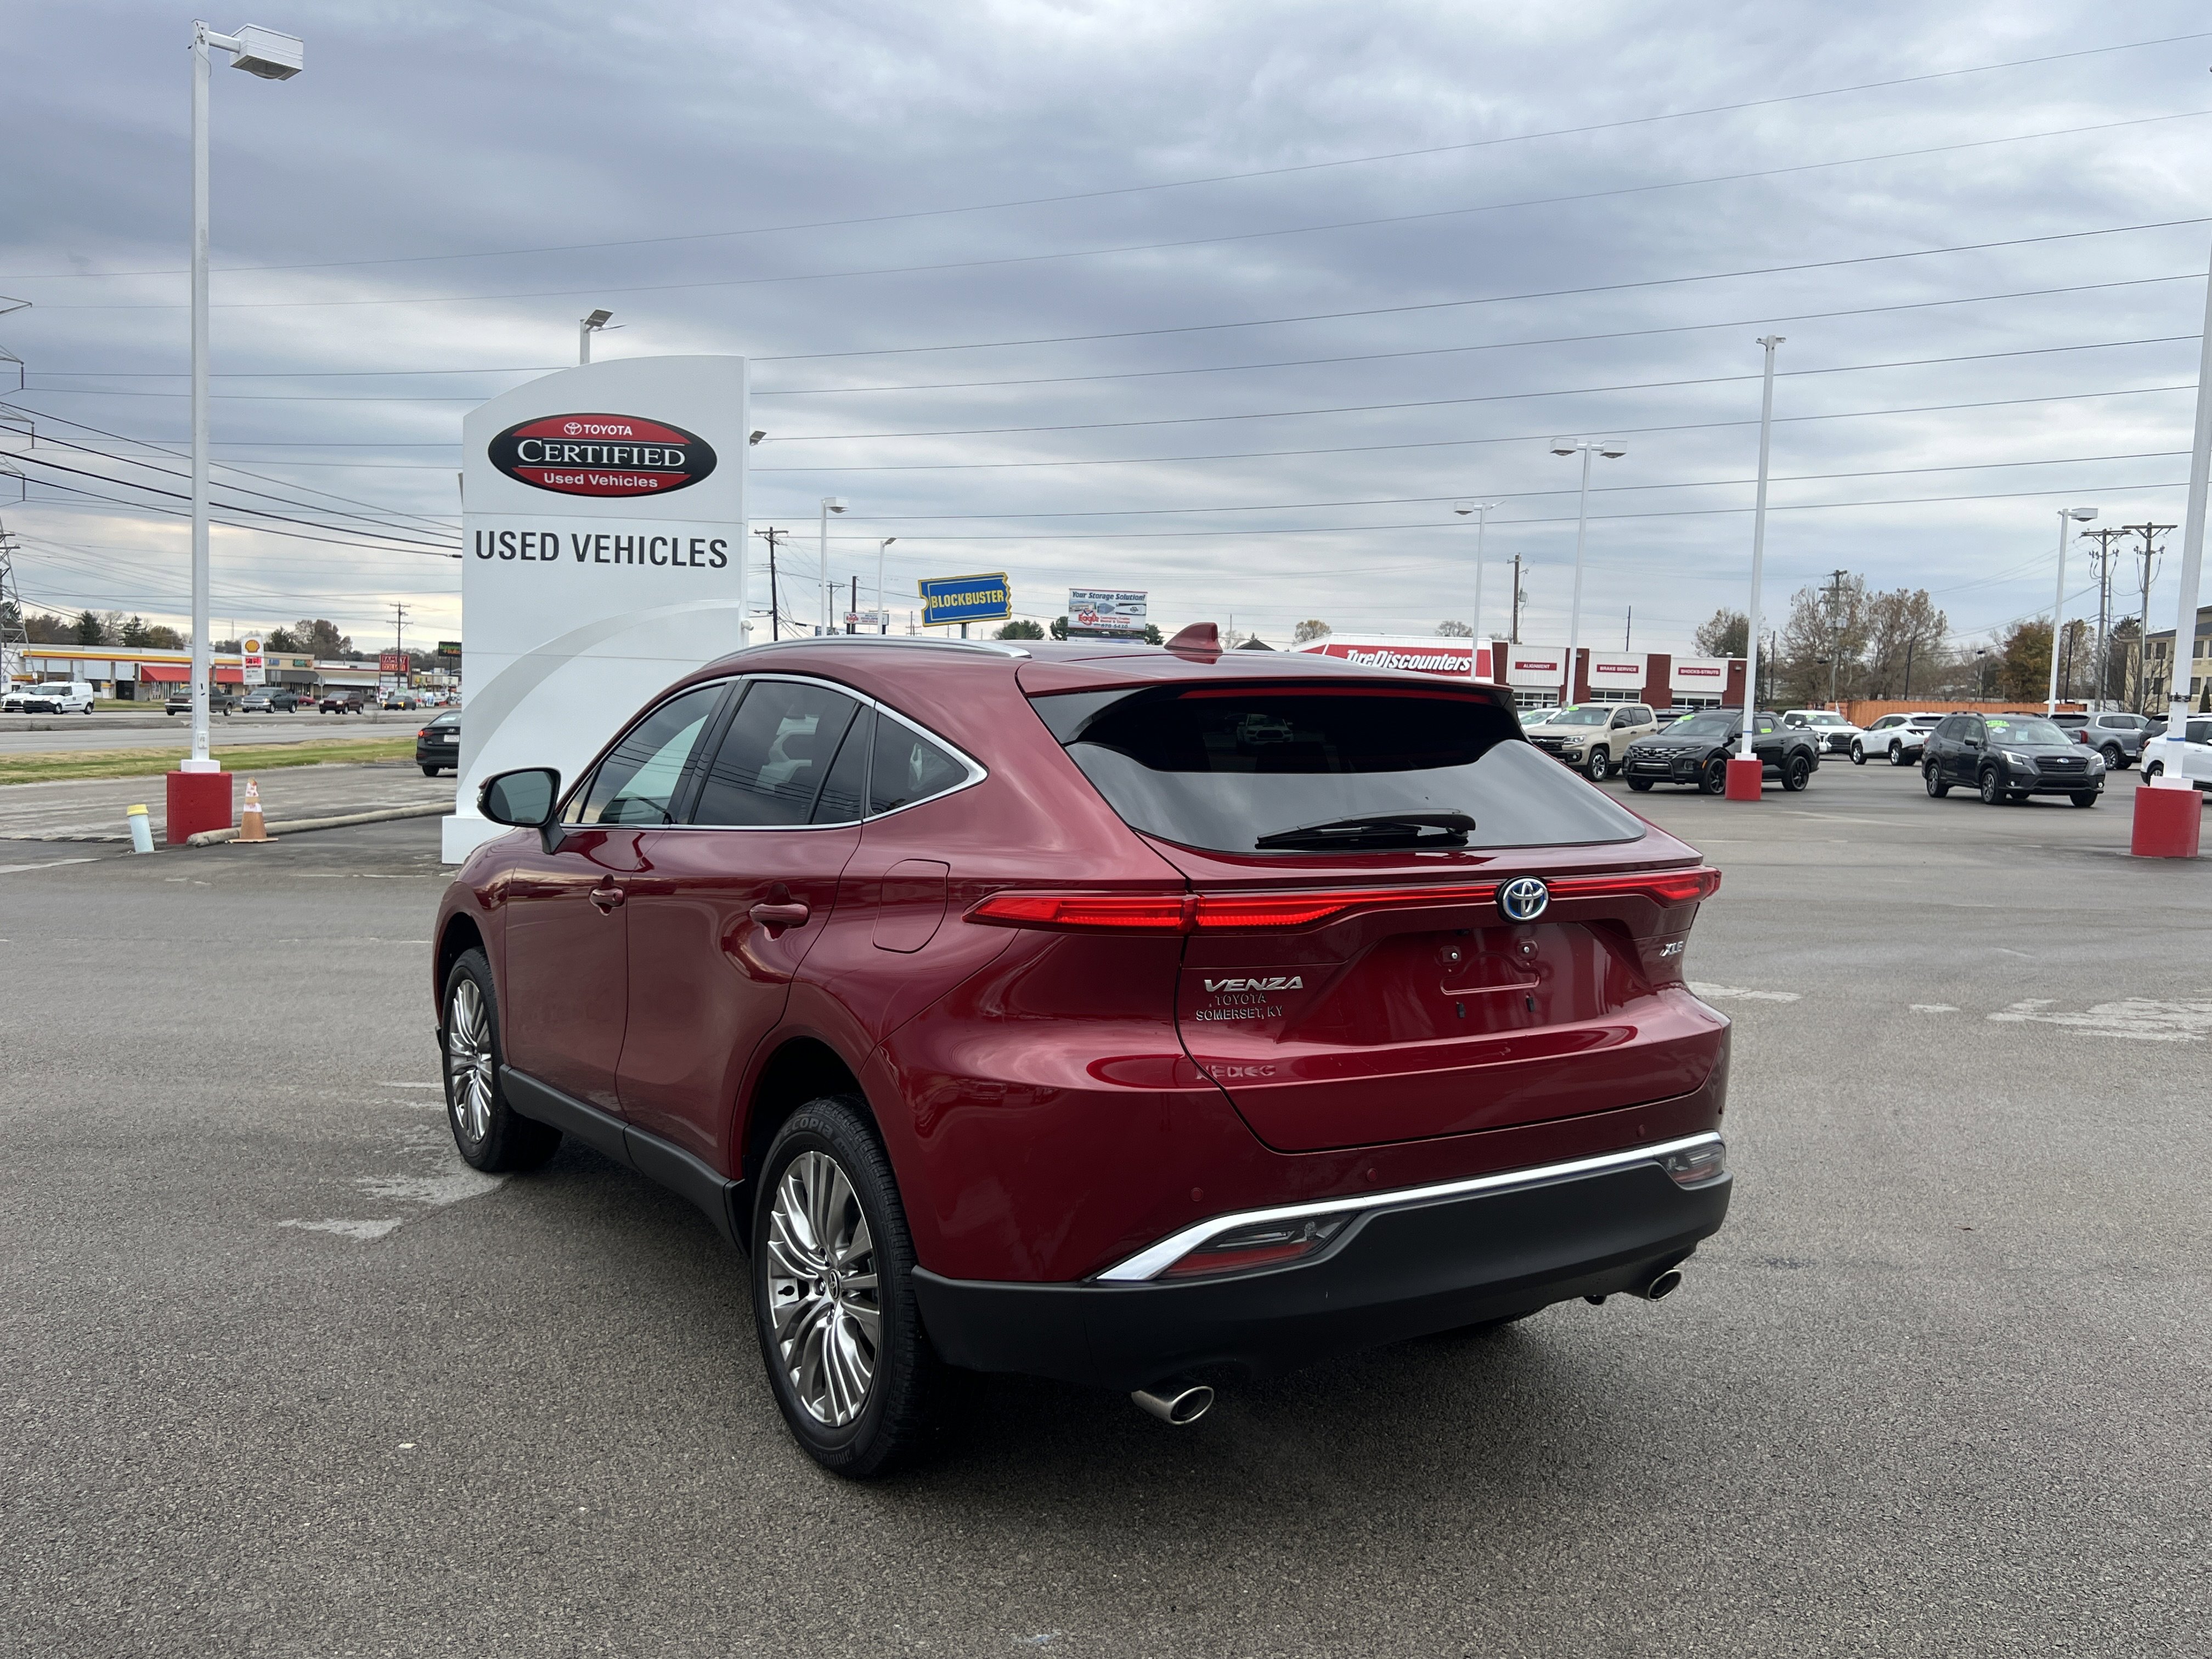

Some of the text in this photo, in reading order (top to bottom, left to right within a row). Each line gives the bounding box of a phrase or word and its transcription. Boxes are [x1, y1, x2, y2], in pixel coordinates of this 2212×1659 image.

[583, 424, 633, 436] TOYOTA
[517, 439, 686, 467] CERTIFIED
[543, 472, 658, 488] Used Vehicles
[475, 530, 728, 568] USED VEHICLES
[931, 590, 1004, 608] BLOCKBUSTER
[1088, 592, 1114, 601] Storage
[1204, 976, 1304, 992] VENZA
[1215, 993, 1267, 1006] TOYOTA
[1196, 1006, 1284, 1021] SOMERSET, KY
